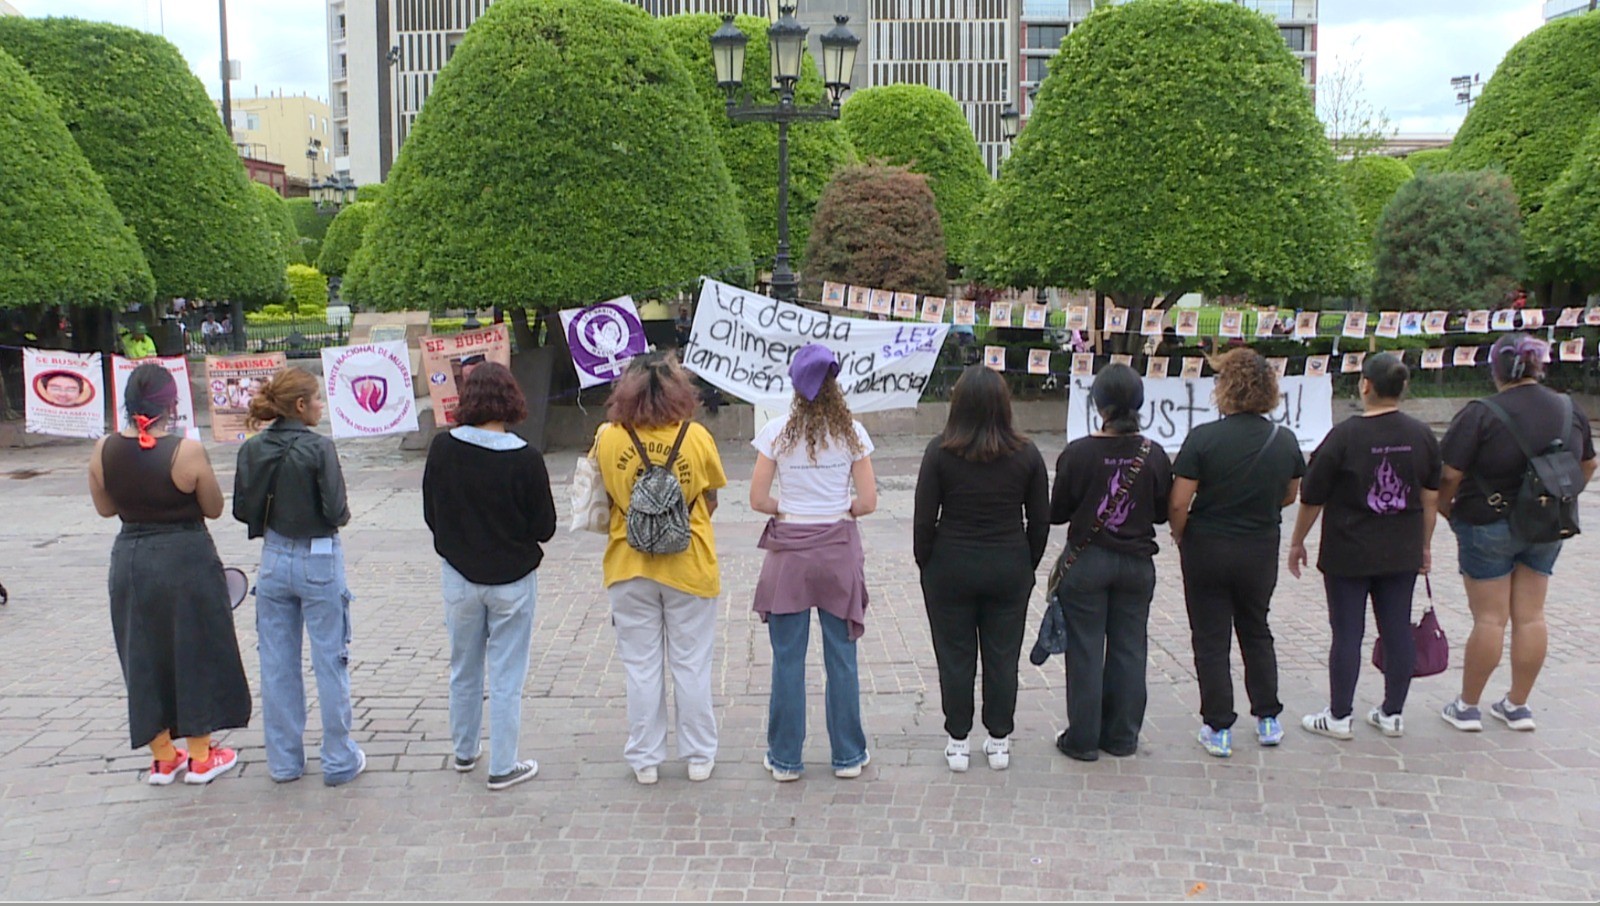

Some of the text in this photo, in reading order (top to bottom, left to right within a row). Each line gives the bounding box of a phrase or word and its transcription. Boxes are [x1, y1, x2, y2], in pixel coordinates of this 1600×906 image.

[715, 284, 745, 318] La
[758, 299, 851, 342] deuda
[426, 330, 503, 352] SE BUSCA
[51, 358, 89, 367] BUSCA
[216, 359, 274, 369] SE BUSCA
[329, 345, 411, 396] FRENTE NACIONAL DE MUJERES
[686, 333, 784, 392] también
[335, 400, 411, 433] CONTRA DEUDORES ALIMENTARIOS
[617, 445, 637, 470] ONLY
